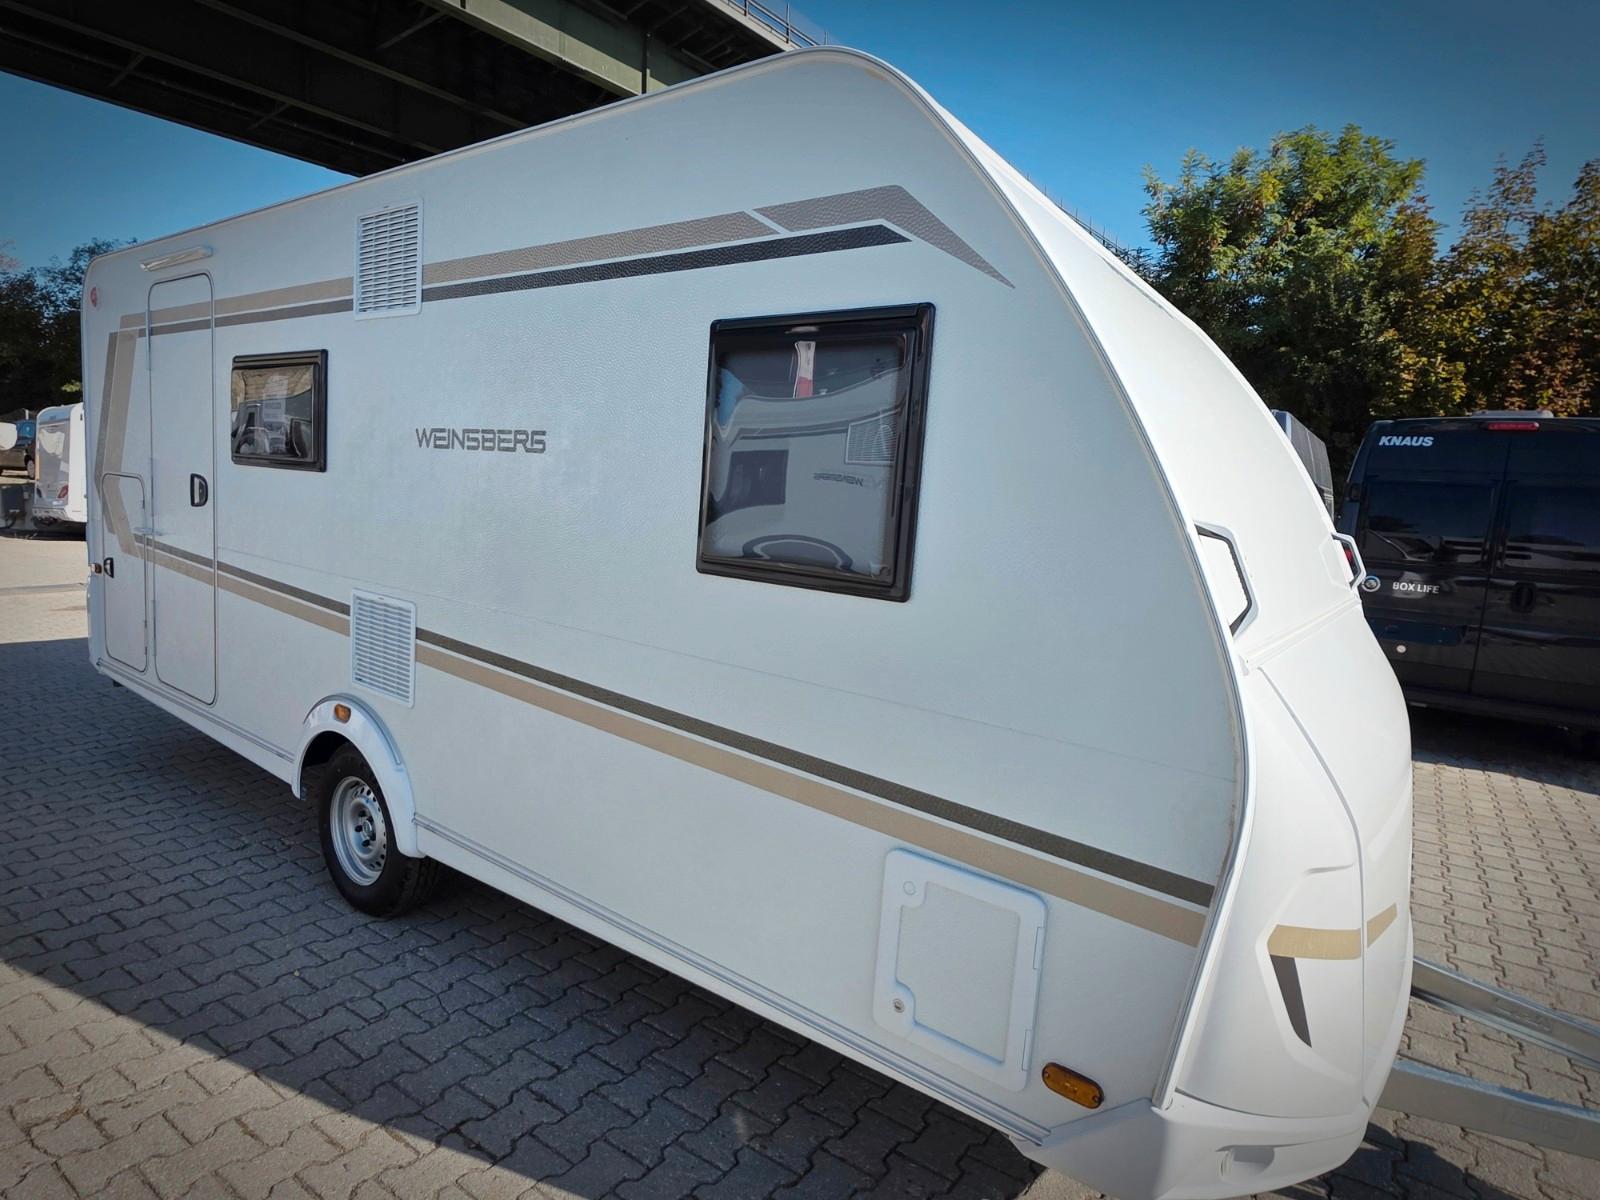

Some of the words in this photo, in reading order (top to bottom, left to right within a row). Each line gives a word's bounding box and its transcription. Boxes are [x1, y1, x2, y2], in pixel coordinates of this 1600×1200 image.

[415, 427, 547, 453] WEINSBERG
[1378, 435, 1434, 447] KNAUS
[1392, 581, 1415, 592] BOX
[1417, 584, 1440, 594] LIFE
